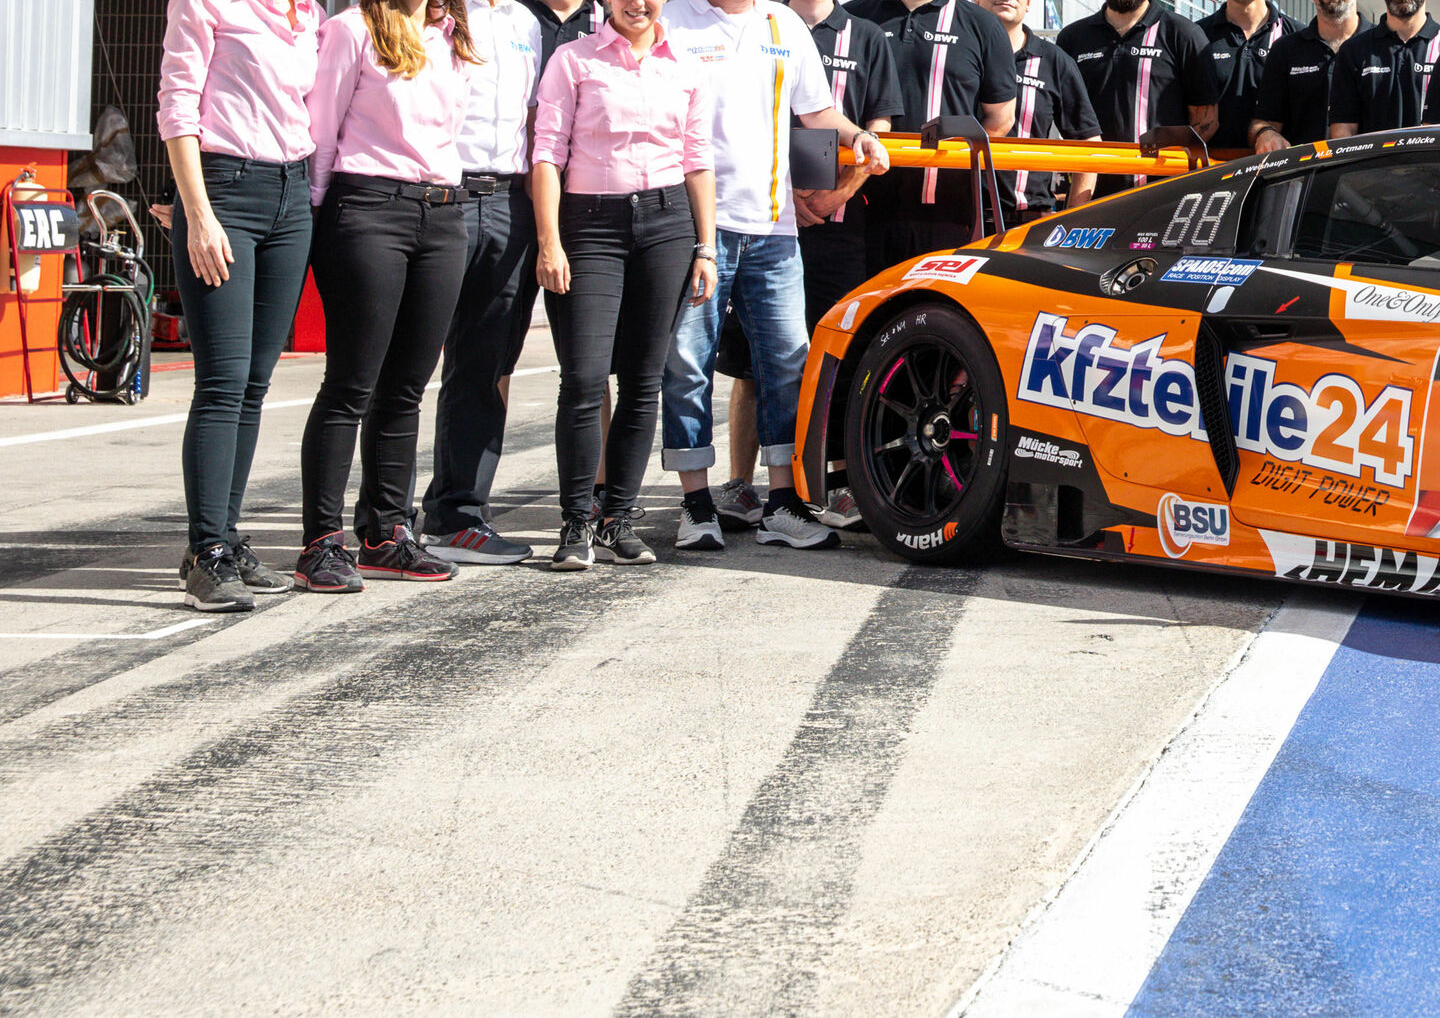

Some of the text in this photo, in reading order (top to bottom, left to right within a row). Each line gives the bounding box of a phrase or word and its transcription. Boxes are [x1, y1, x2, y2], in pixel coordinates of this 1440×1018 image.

[934, 34, 959, 45] BWT
[770, 47, 791, 58] BWT
[1139, 48, 1163, 58] BWT
[833, 58, 857, 71] BWT
[1022, 76, 1046, 89] BWT
[1315, 150, 1333, 159] M.D.
[1335, 143, 1374, 154] Ortmann
[1406, 136, 1436, 145] Mücke
[1063, 228, 1115, 249] BWT
[1217, 274, 1243, 282] DISPLAY
[916, 313, 926, 325] HR
[1024, 319, 1409, 477] kfzteile24
[1017, 436, 1060, 455] Mücke
[1034, 451, 1084, 469] motorsport
[1250, 461, 1390, 517] DIGIT POWER
[1174, 504, 1227, 536] BSU
